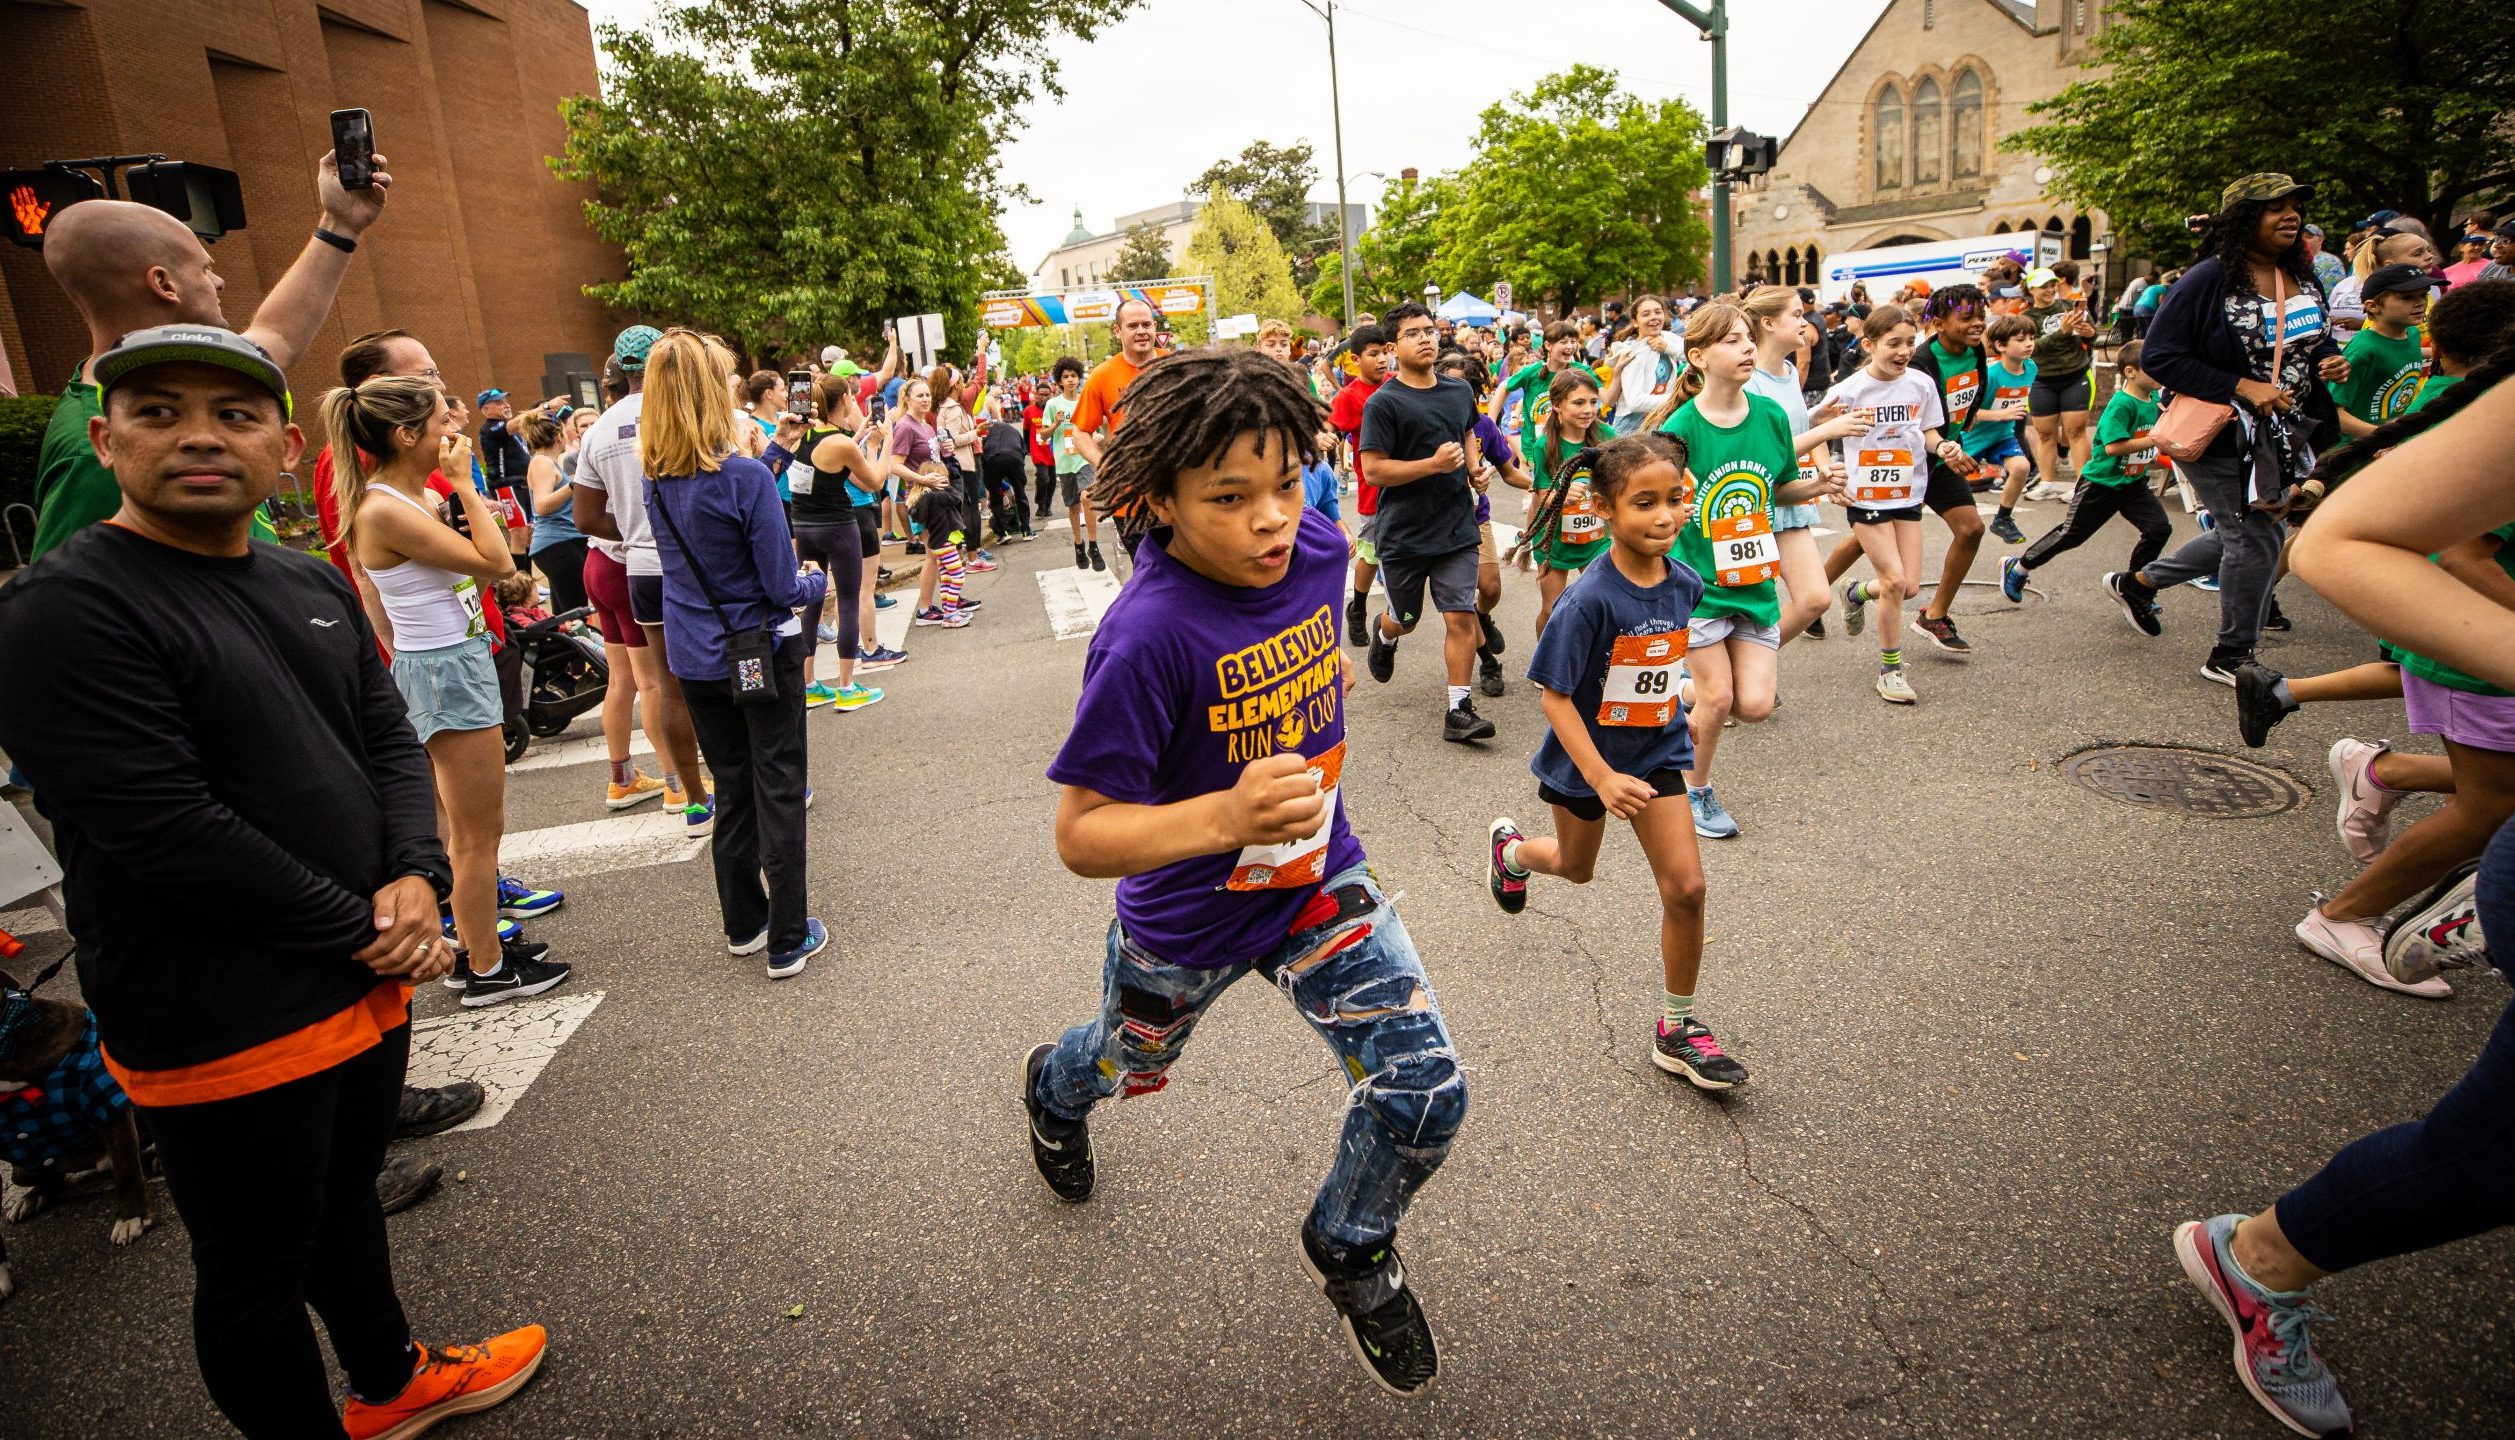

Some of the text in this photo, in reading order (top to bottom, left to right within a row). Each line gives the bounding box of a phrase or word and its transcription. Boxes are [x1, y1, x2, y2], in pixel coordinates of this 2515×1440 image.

[1954, 389, 1975, 407] 398
[2370, 379, 2394, 414] ATLANTIC
[2394, 362, 2413, 380] UNION
[1708, 460, 1738, 483] UNION
[1739, 459, 1767, 477] BANK
[1870, 468, 1900, 482] 875
[1573, 515, 1597, 529] 990
[1730, 539, 1764, 561] 981
[1217, 606, 1334, 698] BELLEVUE
[1208, 647, 1340, 732] ELEMENTARY
[1634, 670, 1669, 694] 89
[1228, 724, 1272, 763] RUN
